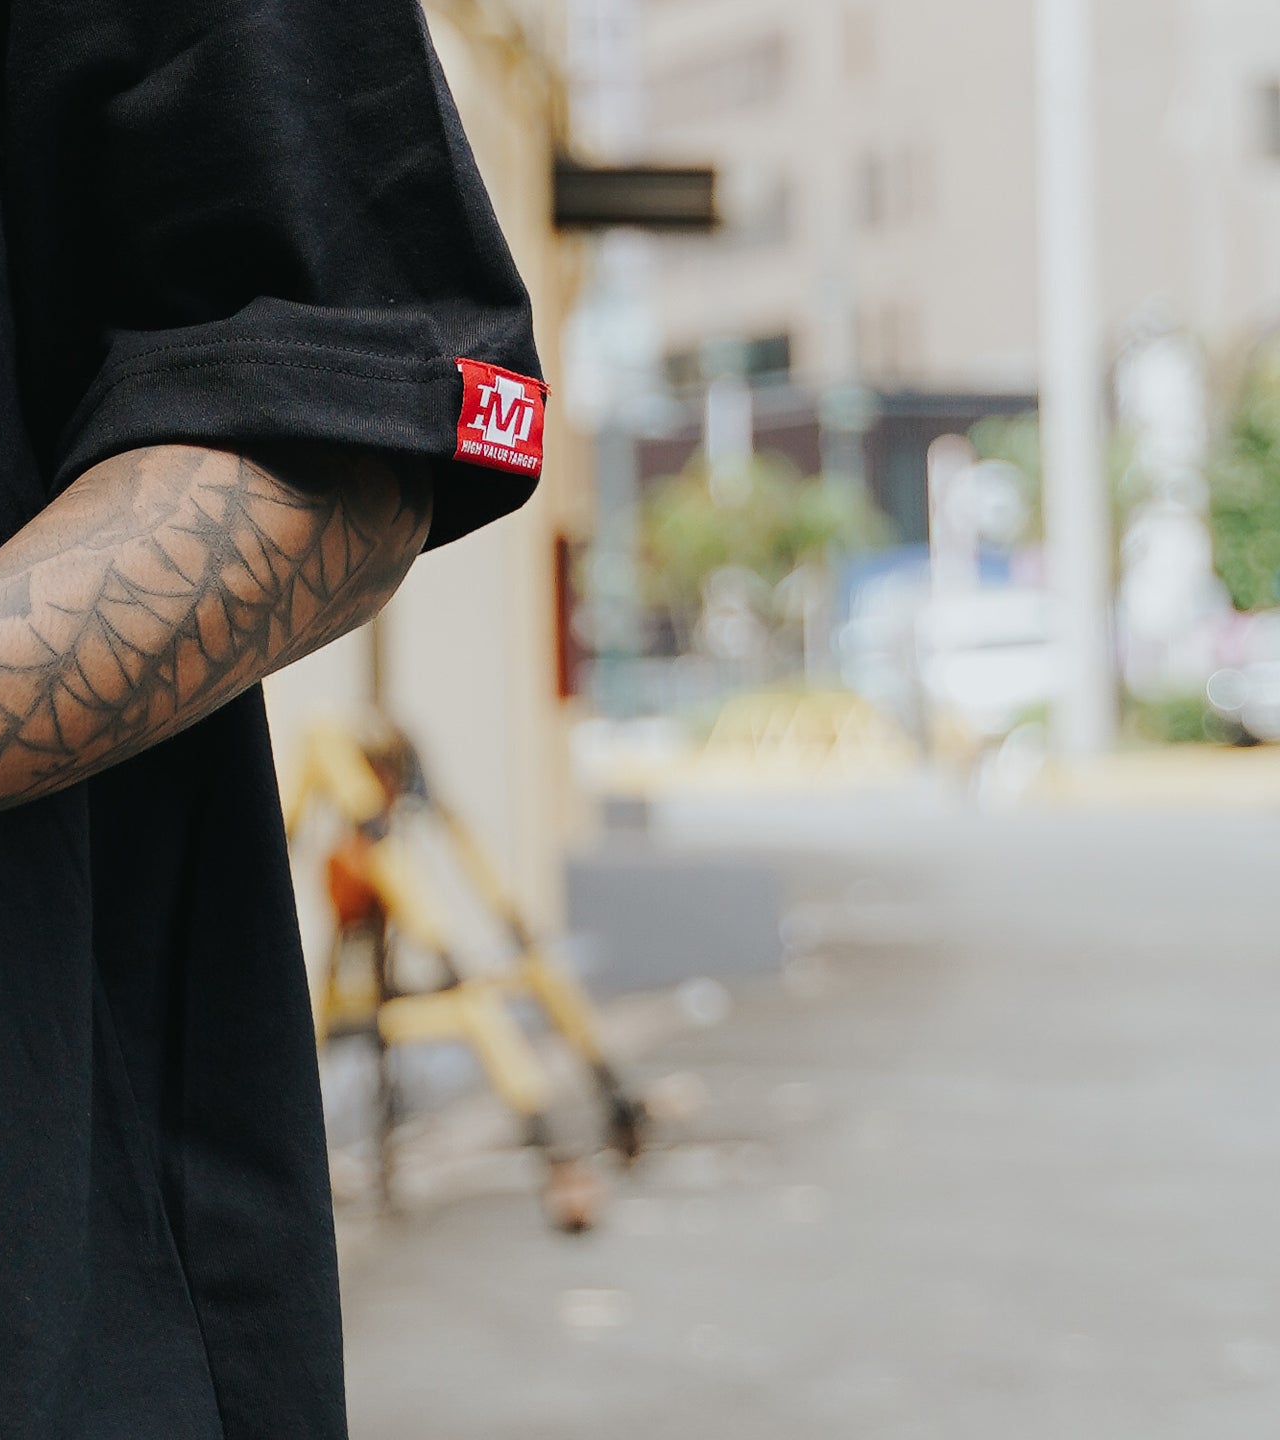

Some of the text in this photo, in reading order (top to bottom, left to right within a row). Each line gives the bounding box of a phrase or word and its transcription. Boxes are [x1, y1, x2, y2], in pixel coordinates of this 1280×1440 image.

[461, 440, 538, 470] HIGH VALUE TARGET
